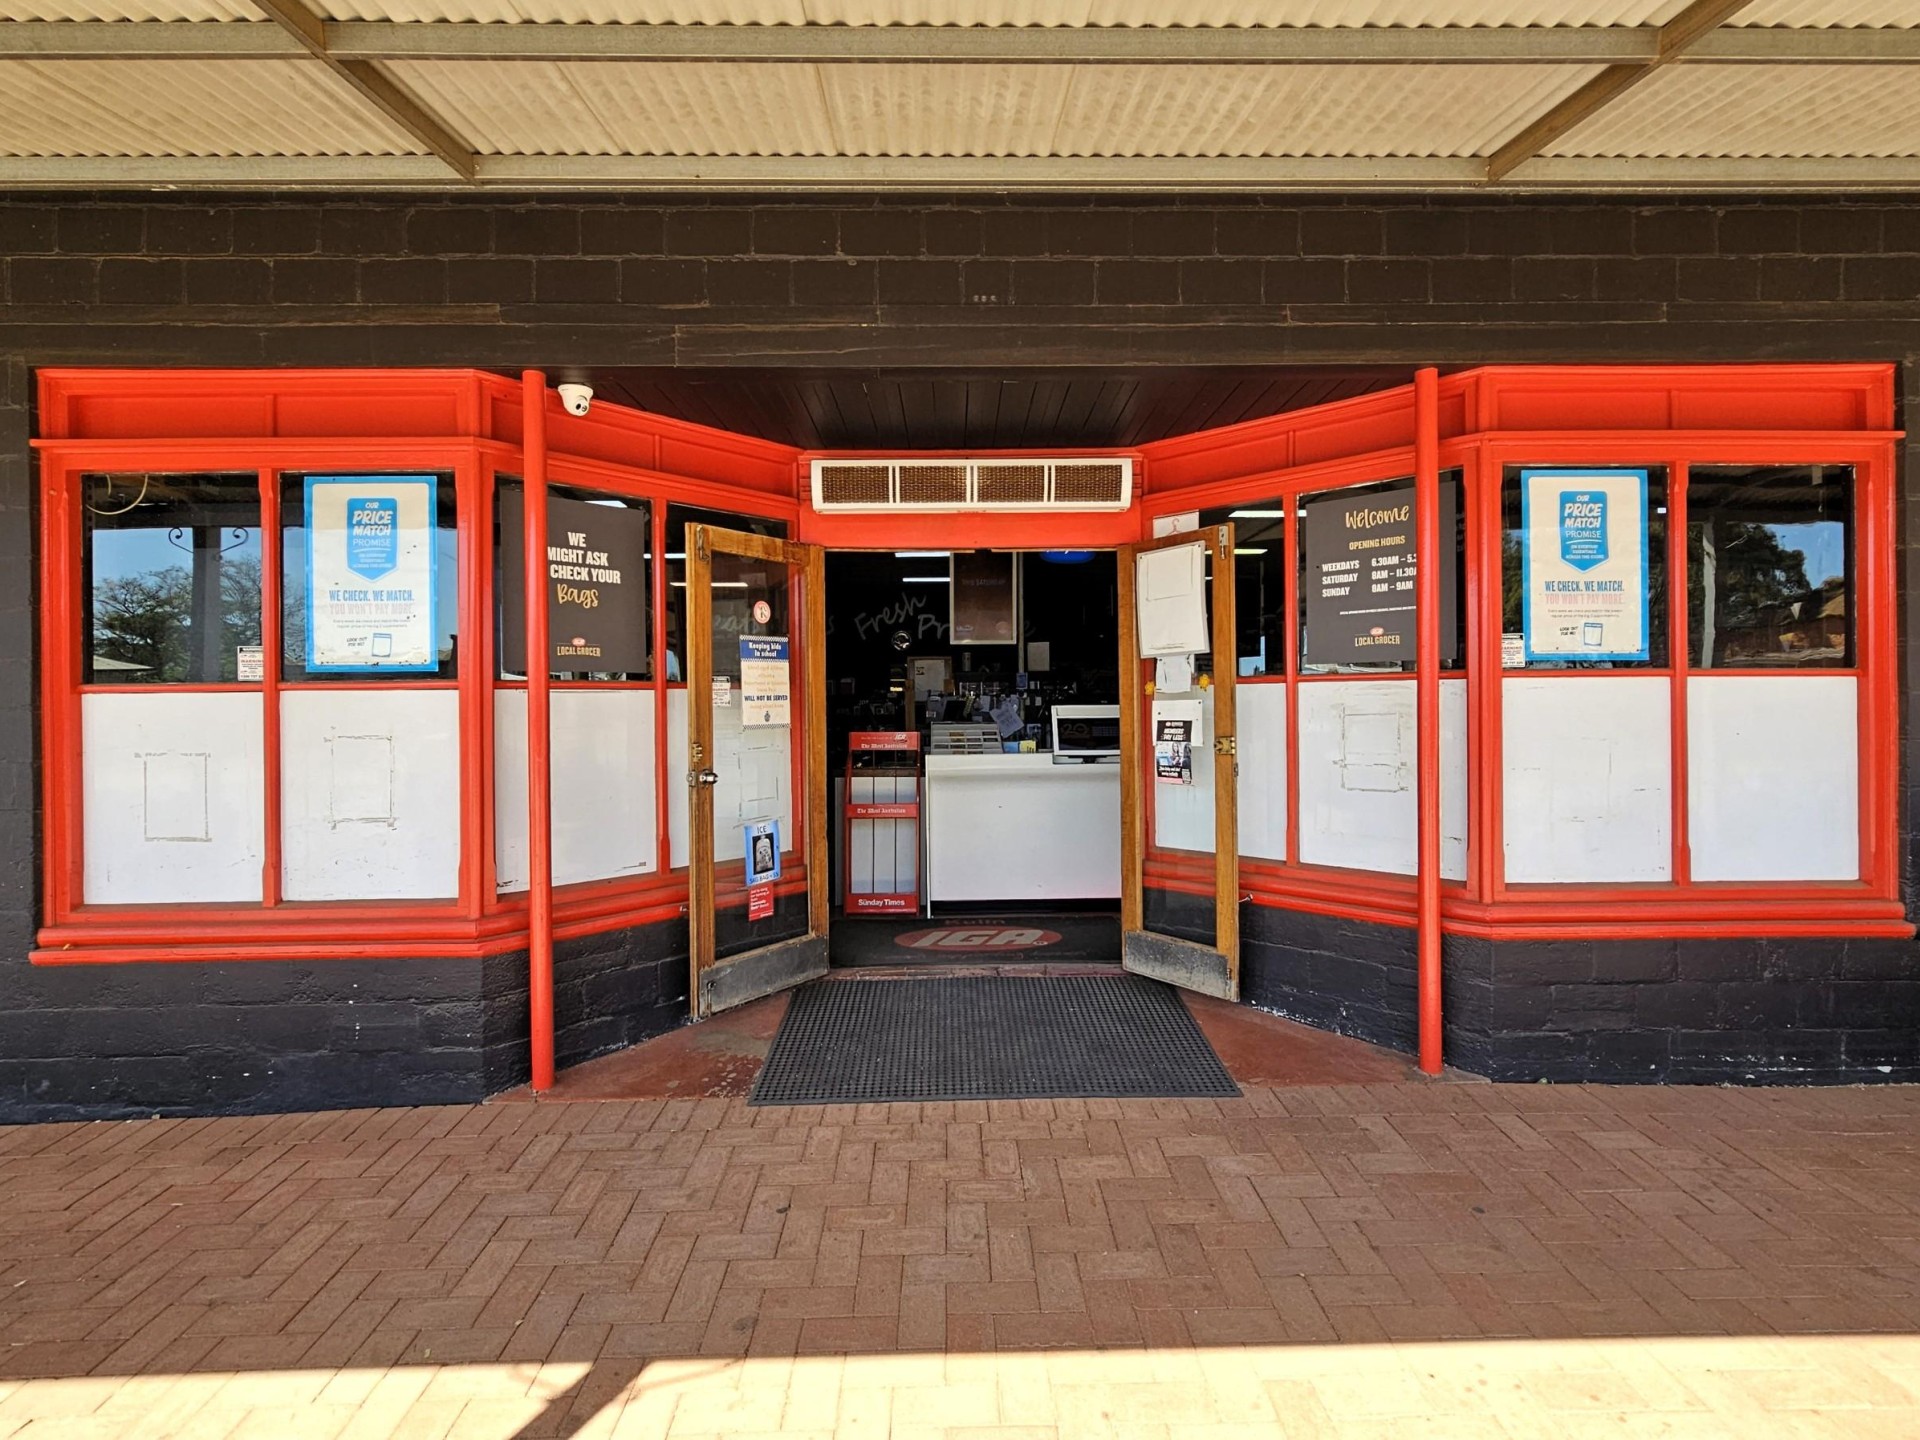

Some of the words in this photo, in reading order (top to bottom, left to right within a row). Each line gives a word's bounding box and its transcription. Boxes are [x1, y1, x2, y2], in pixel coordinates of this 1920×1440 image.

[352, 510, 393, 524] PRICE
[1345, 505, 1410, 529] Welcome
[1564, 503, 1603, 517] PRICE
[352, 524, 391, 536] MATCH
[1564, 517, 1602, 529] MATCH
[567, 531, 586, 547] WE
[1565, 530, 1602, 538] PROMISE
[352, 538, 391, 547] PROMISE
[1349, 538, 1380, 550] OPENING
[1381, 535, 1405, 547] HOURS
[547, 546, 584, 563] MIGHT
[586, 551, 609, 566] ASK
[1322, 560, 1360, 572] WEEKDAYS
[1371, 555, 1399, 567] 6.30AM
[550, 564, 589, 582] CHECK
[590, 568, 621, 584] YOUR
[1322, 573, 1358, 585] SATURDAY
[1371, 570, 1388, 580] 8AM
[1322, 587, 1350, 597] SUNDAY
[1396, 580, 1413, 590] 9AM
[1545, 580, 1555, 591] WE
[1557, 580, 1583, 592] CHECK.
[1584, 580, 1595, 591] WE
[1597, 580, 1624, 592] MATCH.
[329, 590, 341, 601] WE
[343, 590, 370, 601] CHECK.
[373, 590, 385, 601] WE
[386, 590, 415, 601] MATCH.
[556, 583, 598, 608] Bags
[1545, 593, 1559, 605] YOU
[1561, 593, 1584, 605] WON'T
[1586, 593, 1599, 605] PAY
[329, 603, 345, 615] YOU
[375, 603, 389, 615] PAY
[854, 591, 926, 640] Fresh
[1354, 637, 1374, 647] LOCAL
[1375, 635, 1400, 645] GROCER
[557, 646, 576, 656] LOCAL
[577, 647, 601, 657] GROCER
[757, 826, 767, 834] ICE
[911, 930, 1044, 947] IGA
